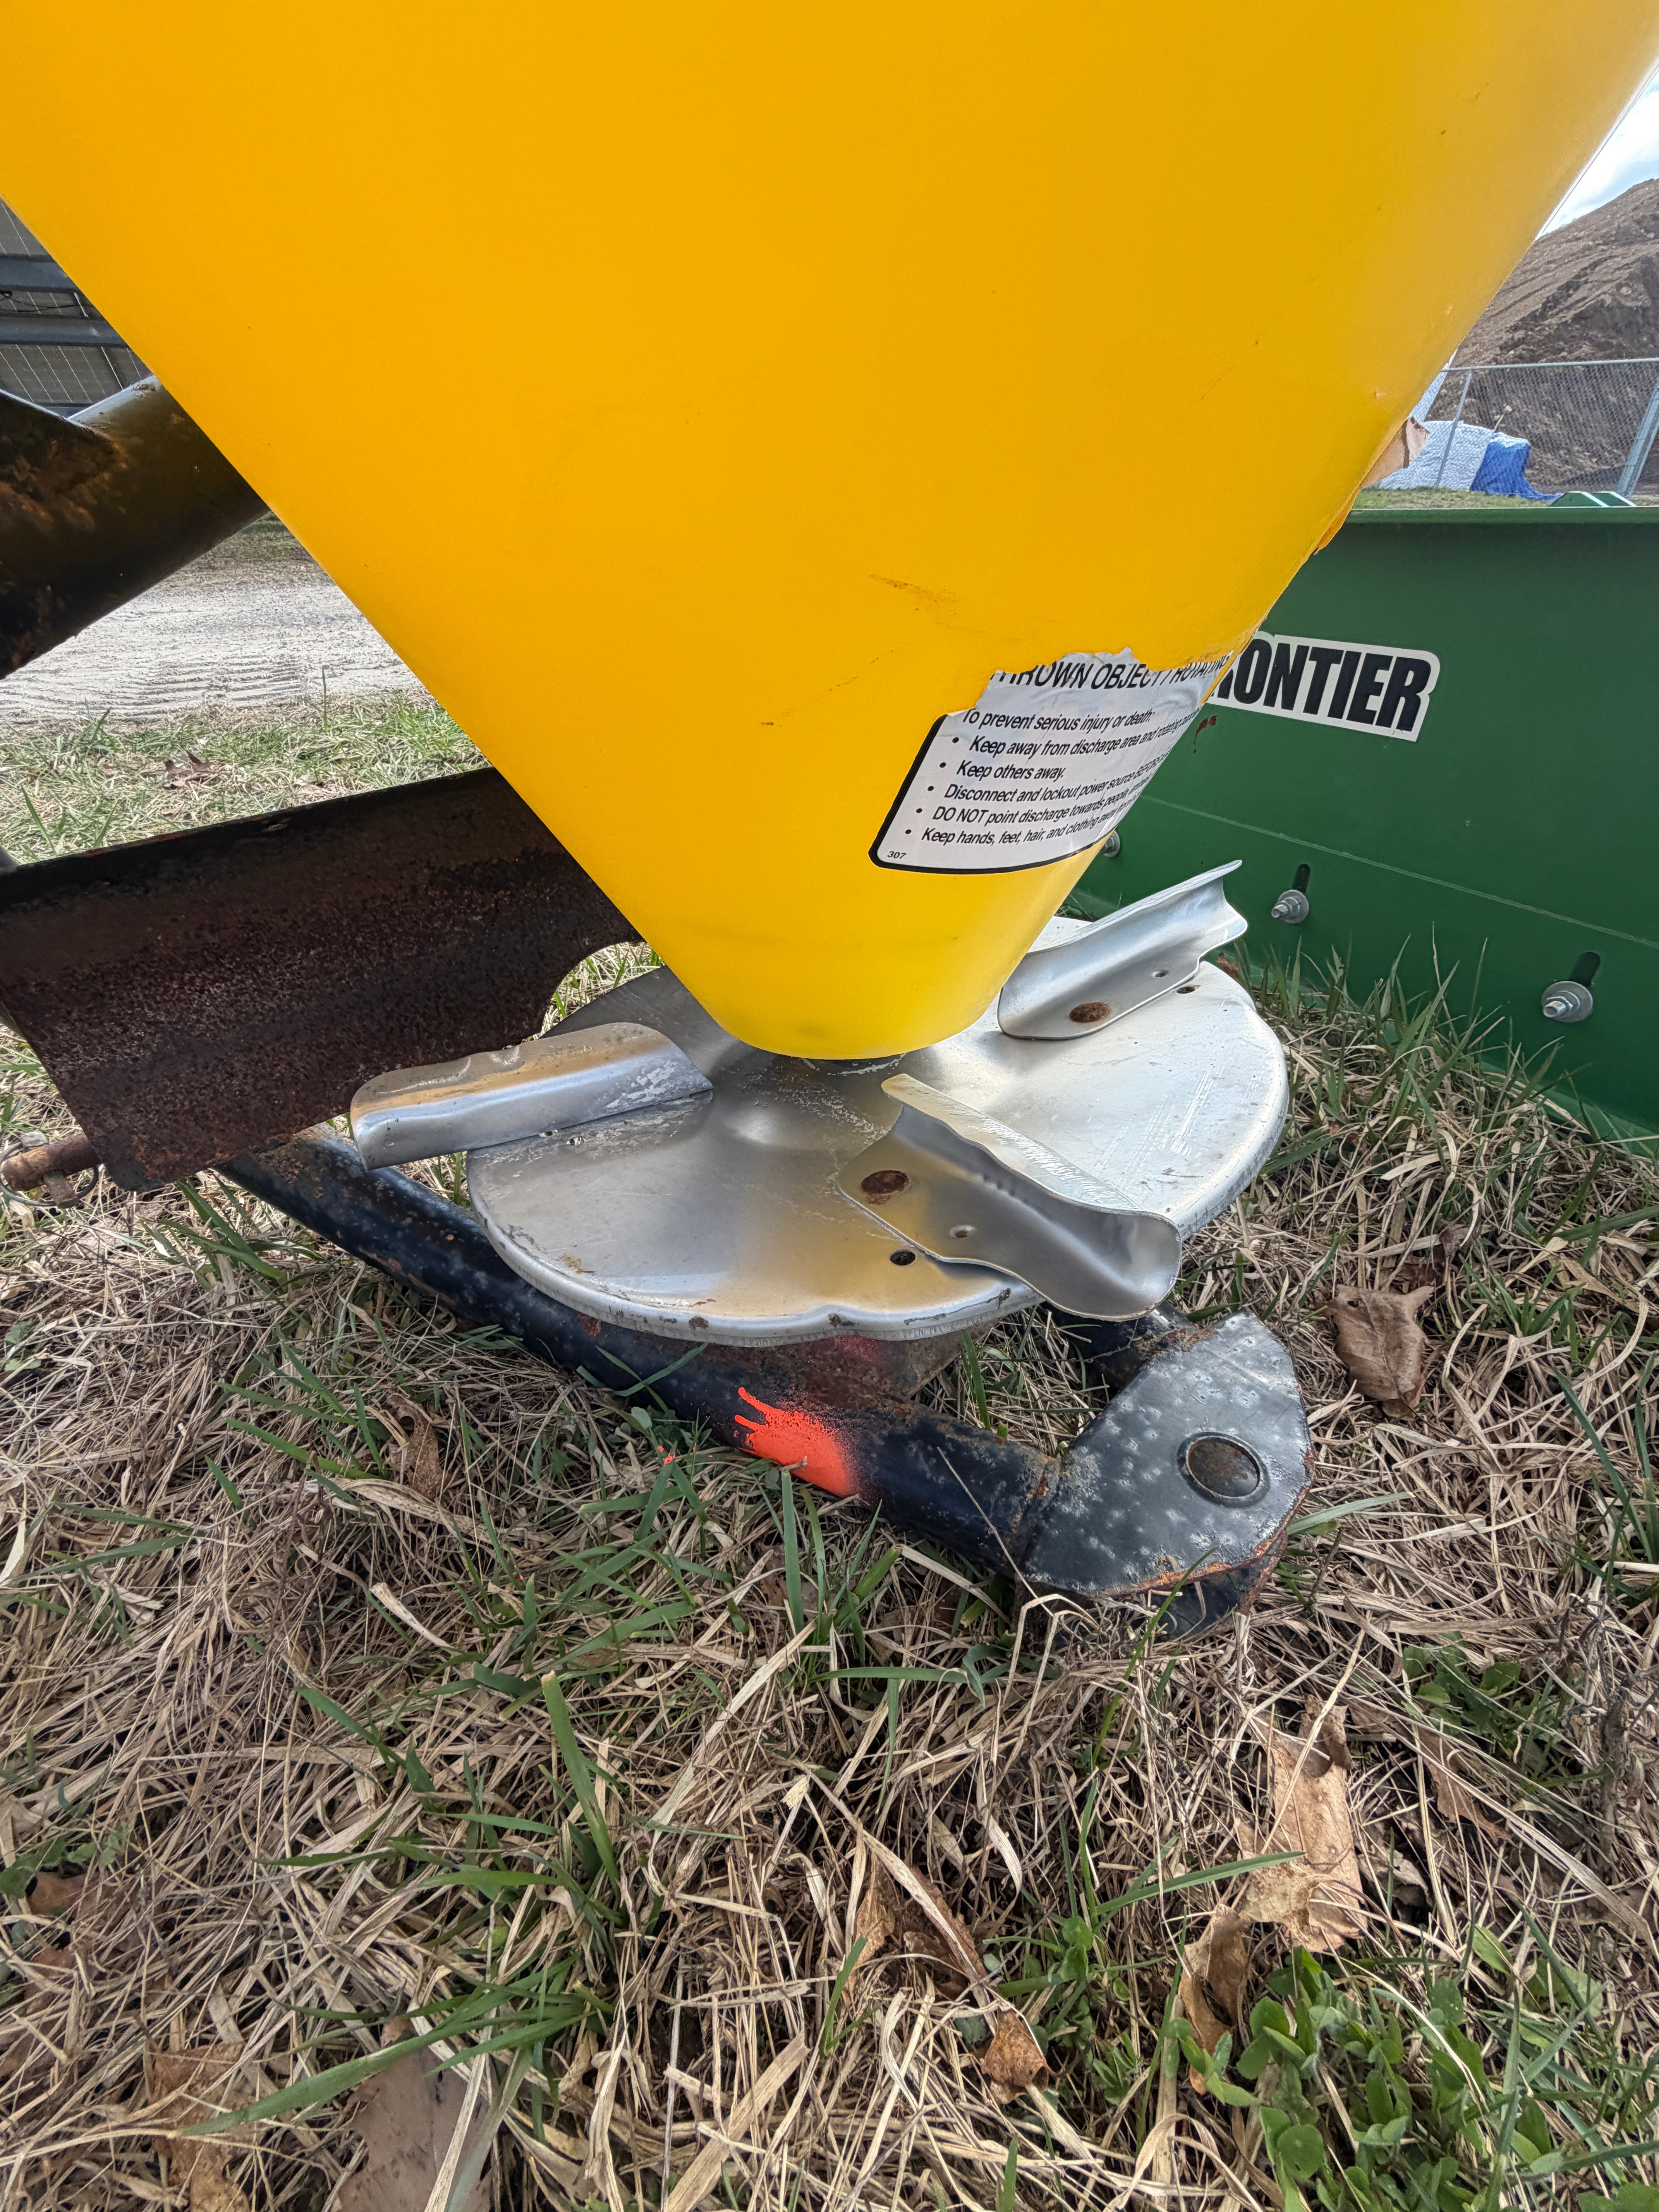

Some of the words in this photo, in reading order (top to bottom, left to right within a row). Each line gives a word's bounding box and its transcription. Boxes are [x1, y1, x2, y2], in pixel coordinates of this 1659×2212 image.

[963, 708, 980, 724] To
[978, 713, 1036, 730] prevent
[1034, 714, 1081, 730] serious
[1080, 714, 1114, 734] injury
[1112, 715, 1124, 728] or
[1124, 708, 1156, 726] death:
[969, 735, 1006, 758] Keep
[1006, 742, 1042, 760] away
[1041, 740, 1070, 756] from
[1070, 738, 1121, 755] discharge
[1119, 734, 1142, 749] area
[1139, 726, 1160, 744] and
[956, 759, 992, 781] Keep
[993, 764, 1034, 779] others
[1034, 767, 1066, 782] away.
[944, 783, 1018, 802] Disconnect
[1016, 787, 1042, 802] and
[1039, 784, 1081, 801] lockout
[1076, 781, 1110, 800] power
[1106, 772, 1136, 790] source
[932, 806, 957, 821] DO
[956, 808, 989, 824] NOT
[984, 810, 1019, 827] point
[1018, 807, 1070, 826] discharge
[1069, 799, 1105, 817] towards
[921, 827, 956, 846] Keep
[956, 830, 996, 846] hands,
[998, 830, 1022, 845] feet,
[1022, 828, 1046, 842] hair,
[1046, 824, 1070, 840] and
[1065, 816, 1099, 835] clothing
[887, 851, 907, 859] 307
